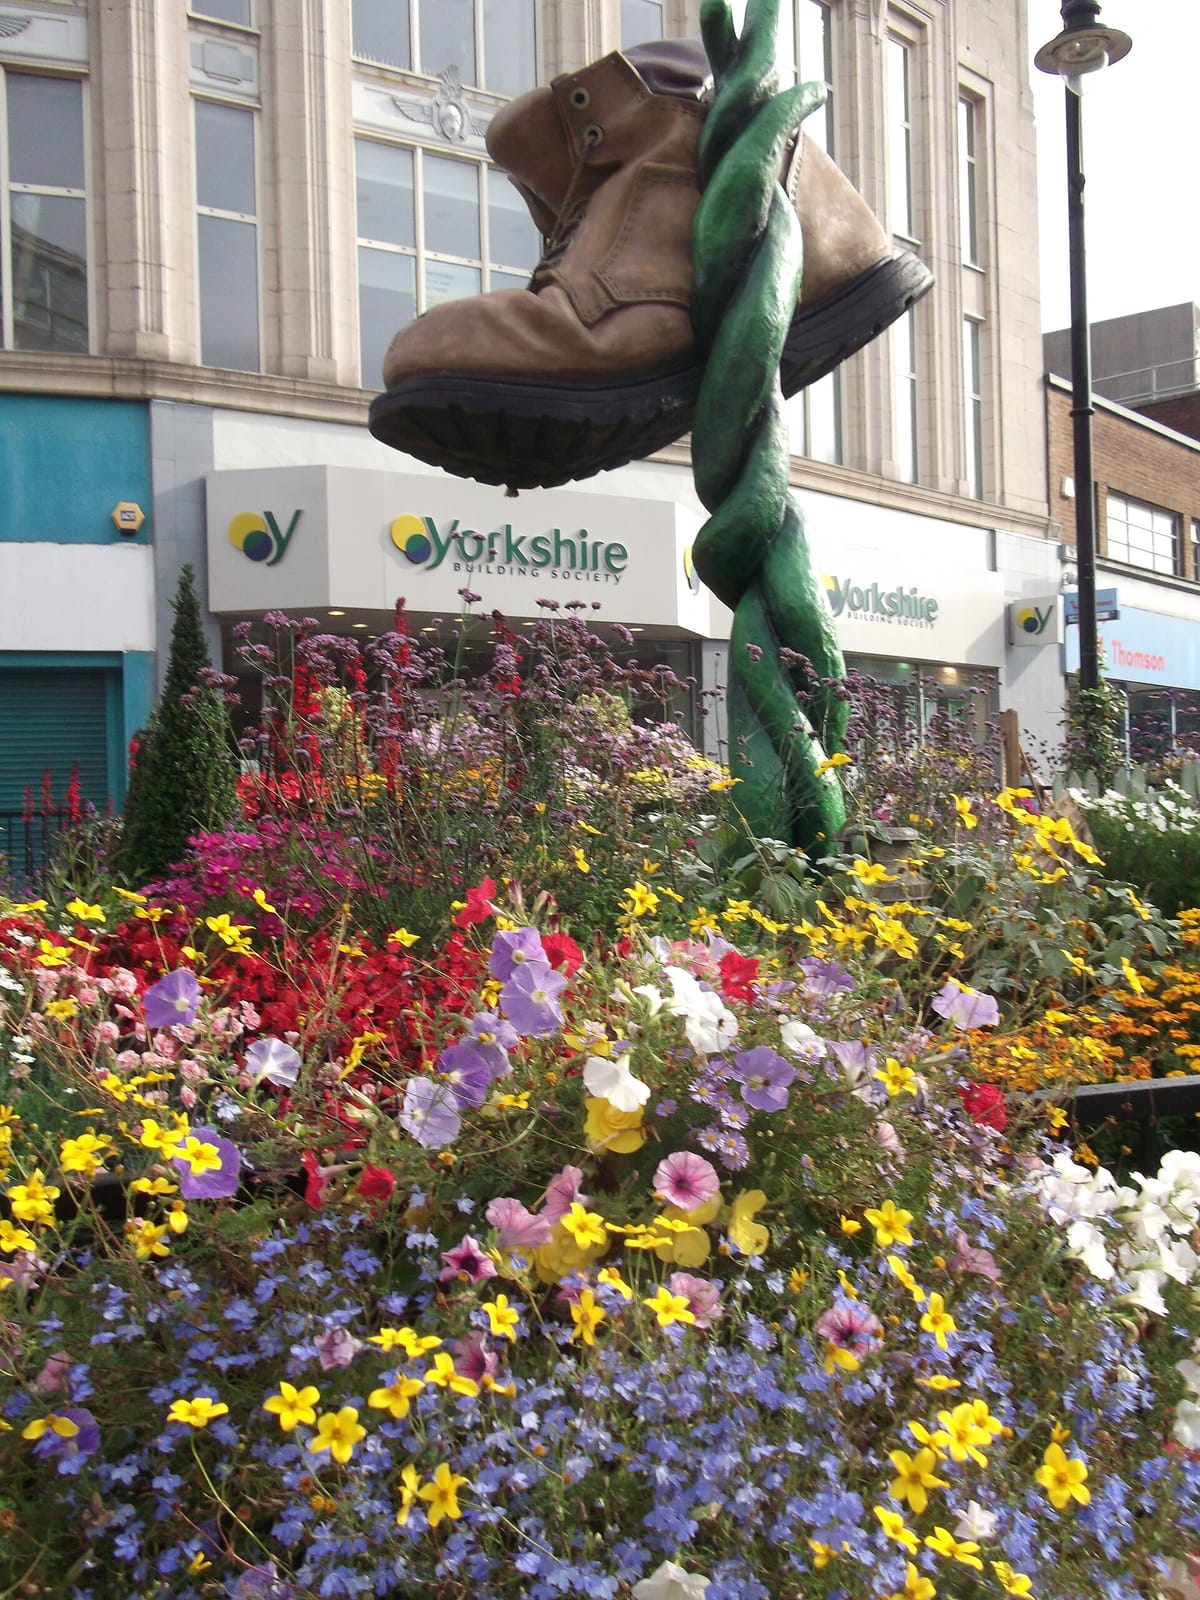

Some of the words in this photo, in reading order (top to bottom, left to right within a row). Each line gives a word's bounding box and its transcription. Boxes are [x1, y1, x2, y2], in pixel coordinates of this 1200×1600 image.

[453, 562, 540, 578] BUILDING
[551, 570, 623, 585] SOCIETY
[847, 611, 893, 625] BUILDING
[897, 617, 935, 630] SOCIETY
[1111, 639, 1166, 672] Thomson
